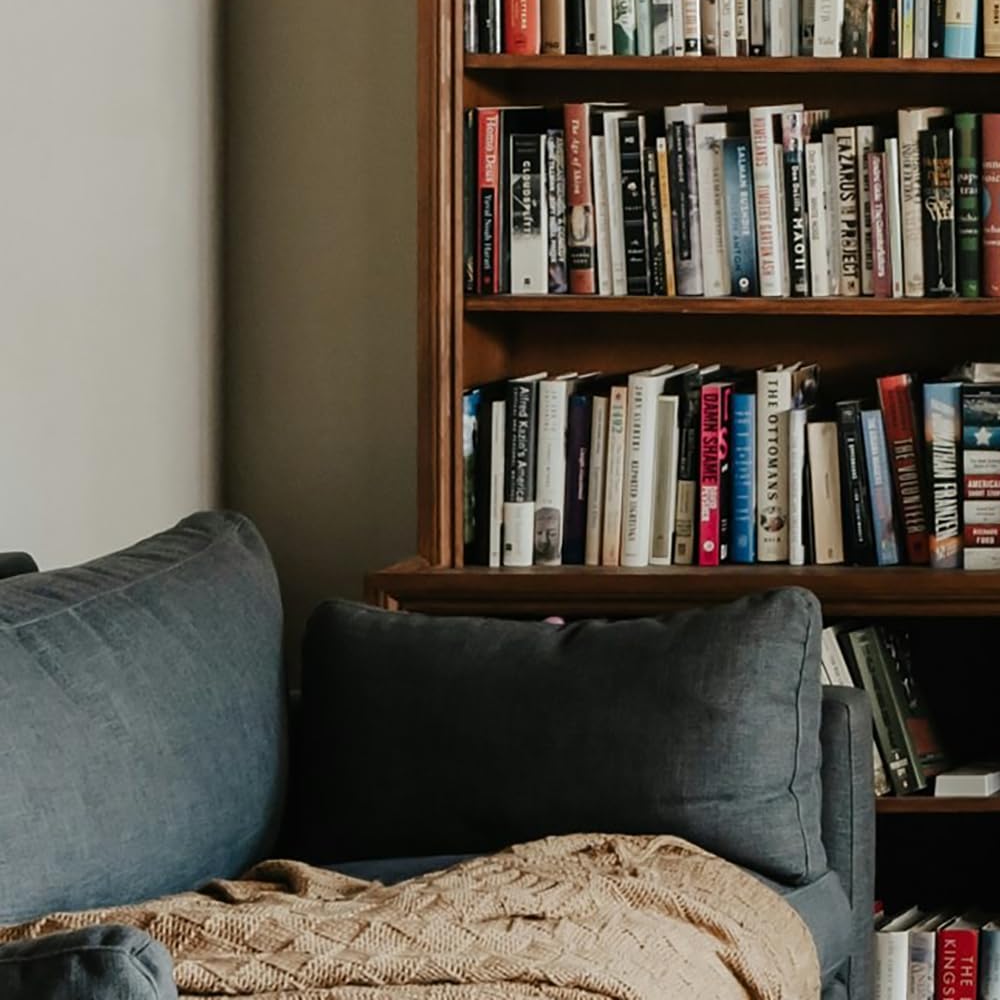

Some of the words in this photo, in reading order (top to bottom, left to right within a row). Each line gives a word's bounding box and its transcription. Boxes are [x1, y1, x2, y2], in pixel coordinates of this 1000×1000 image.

[486, 117, 496, 151] Homo
[486, 154, 496, 182] Deus
[572, 158, 581, 166] of
[736, 147, 746, 188] SALMAN
[837, 136, 856, 201] LAZARUS
[740, 191, 750, 236] RUSHDIE
[754, 118, 767, 167] HOMELANDS
[763, 260, 773, 275] ASH
[840, 220, 857, 278] PROJECT
[519, 387, 529, 417] Alfred
[704, 393, 718, 432] DAMN
[768, 380, 778, 408] THE
[518, 421, 528, 458] Kazin's
[703, 436, 719, 482] SHAME
[768, 414, 778, 500] OTTOMANS
[895, 438, 913, 460] THE
[517, 460, 527, 502] America
[899, 466, 924, 533] VOLUNTEER
[934, 482, 958, 541] FRANZEN
[960, 956, 974, 986] THE
